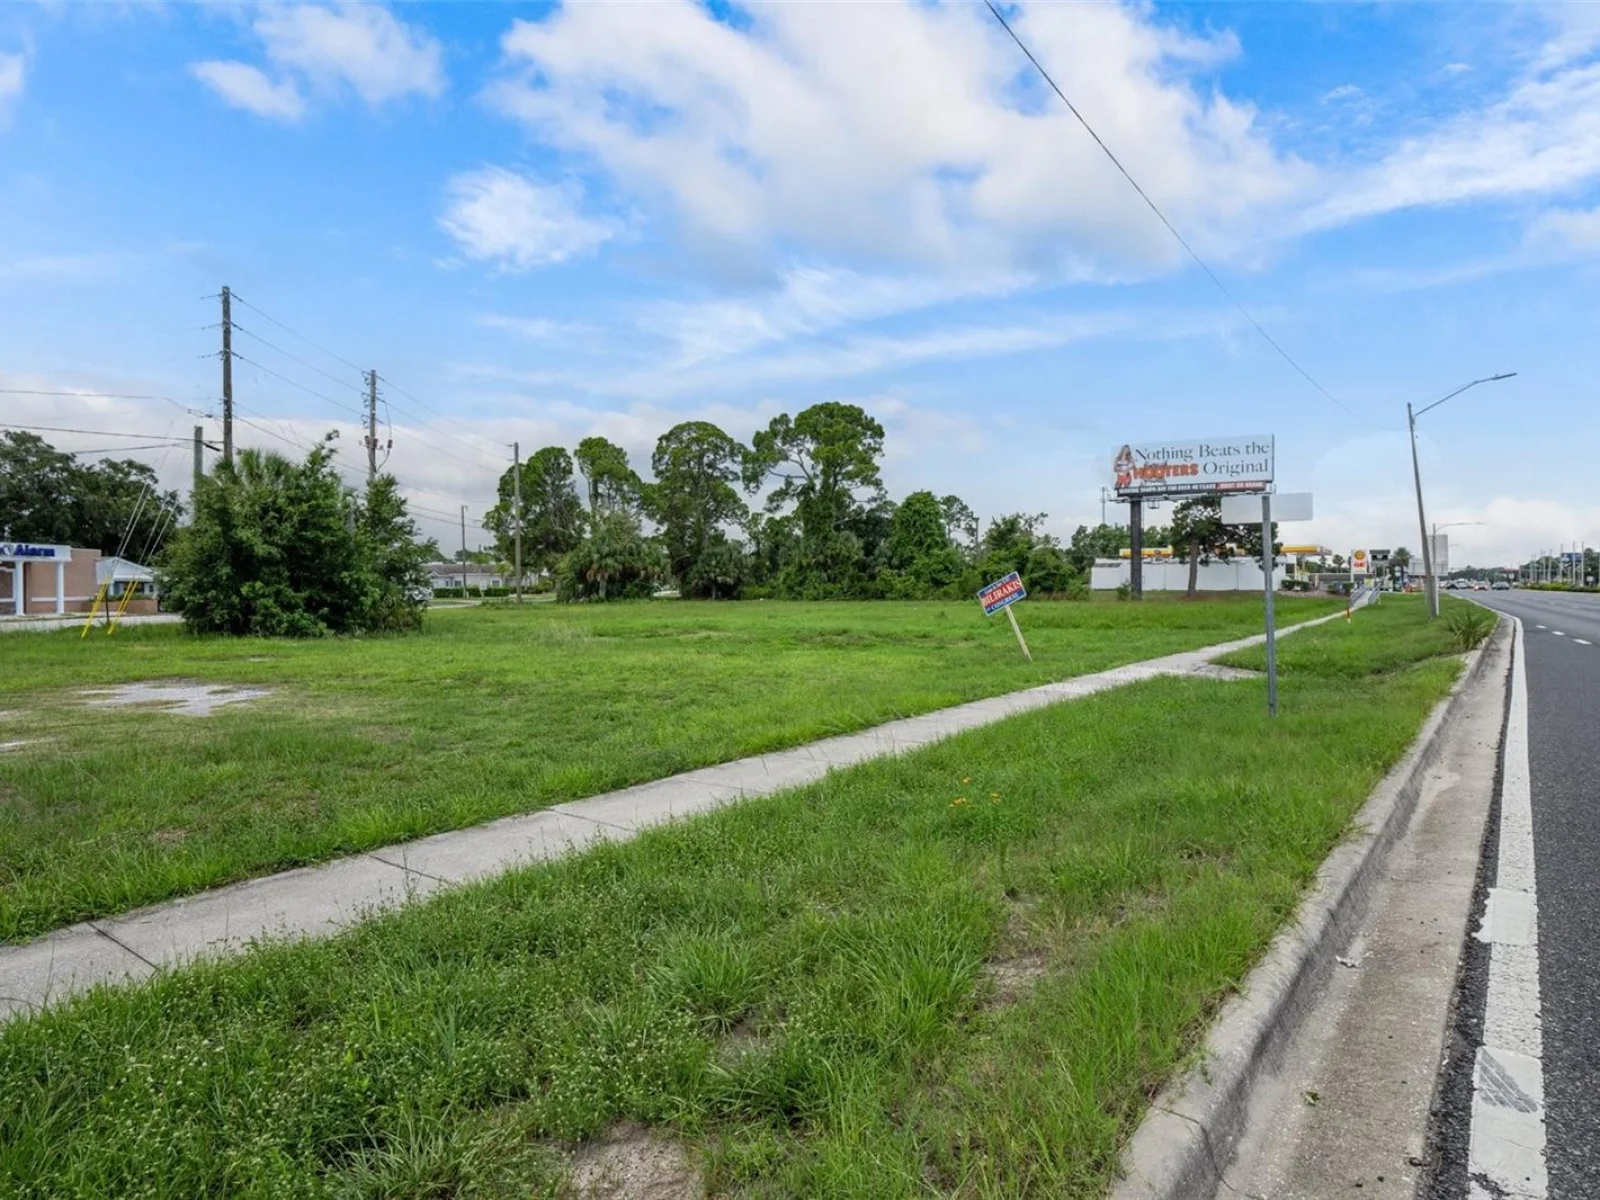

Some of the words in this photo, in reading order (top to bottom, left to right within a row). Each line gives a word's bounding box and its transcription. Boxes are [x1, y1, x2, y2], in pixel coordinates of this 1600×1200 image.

[1135, 447, 1194, 462] Nothing
[1199, 444, 1241, 458] Beats
[1246, 441, 1270, 454] the
[1133, 463, 1199, 480] HOOTERS
[1203, 459, 1269, 477] Original
[980, 580, 1022, 607] BILIRAKIS
